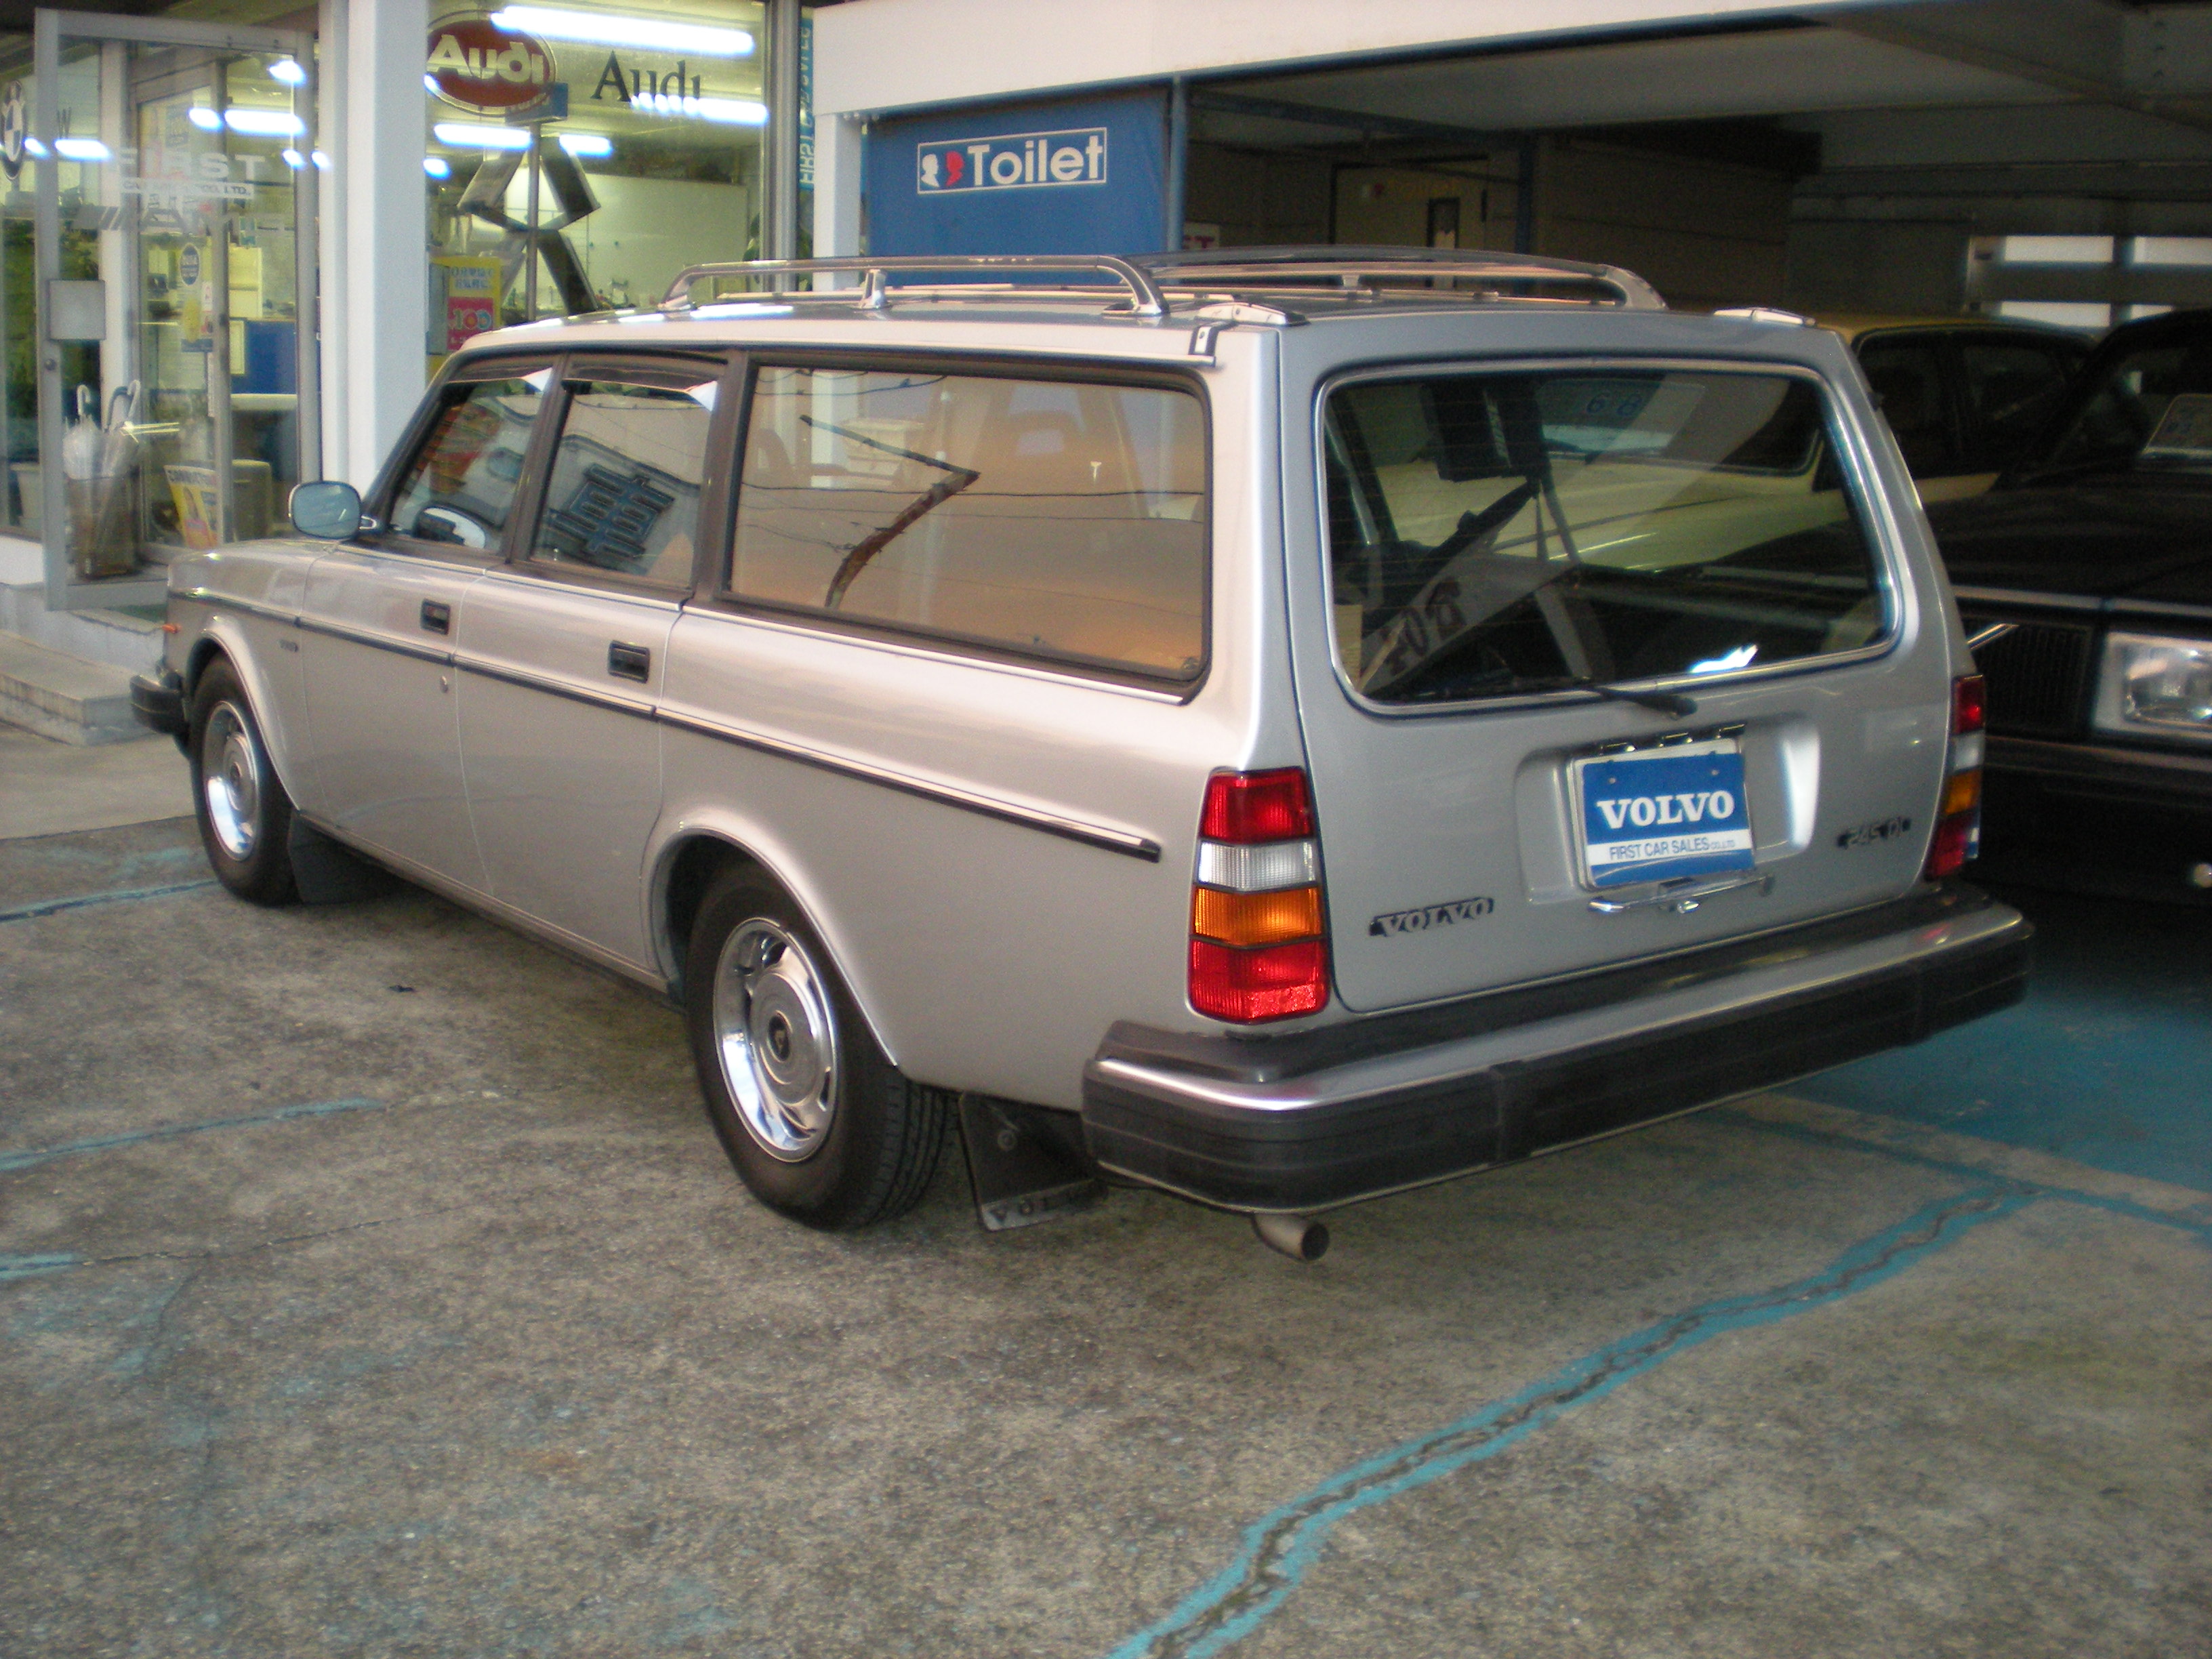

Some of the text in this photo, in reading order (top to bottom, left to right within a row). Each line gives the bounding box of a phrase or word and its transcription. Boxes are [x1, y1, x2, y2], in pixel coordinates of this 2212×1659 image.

[427, 34, 544, 84] Audi
[590, 49, 701, 102] Audi
[967, 135, 1103, 186] Toilet
[1596, 790, 1736, 830] VOLVO
[1609, 844, 1642, 861] FIRST
[1644, 841, 1668, 857] CAR
[1671, 836, 1708, 854] SALES
[1376, 897, 1491, 937] VOLVO
